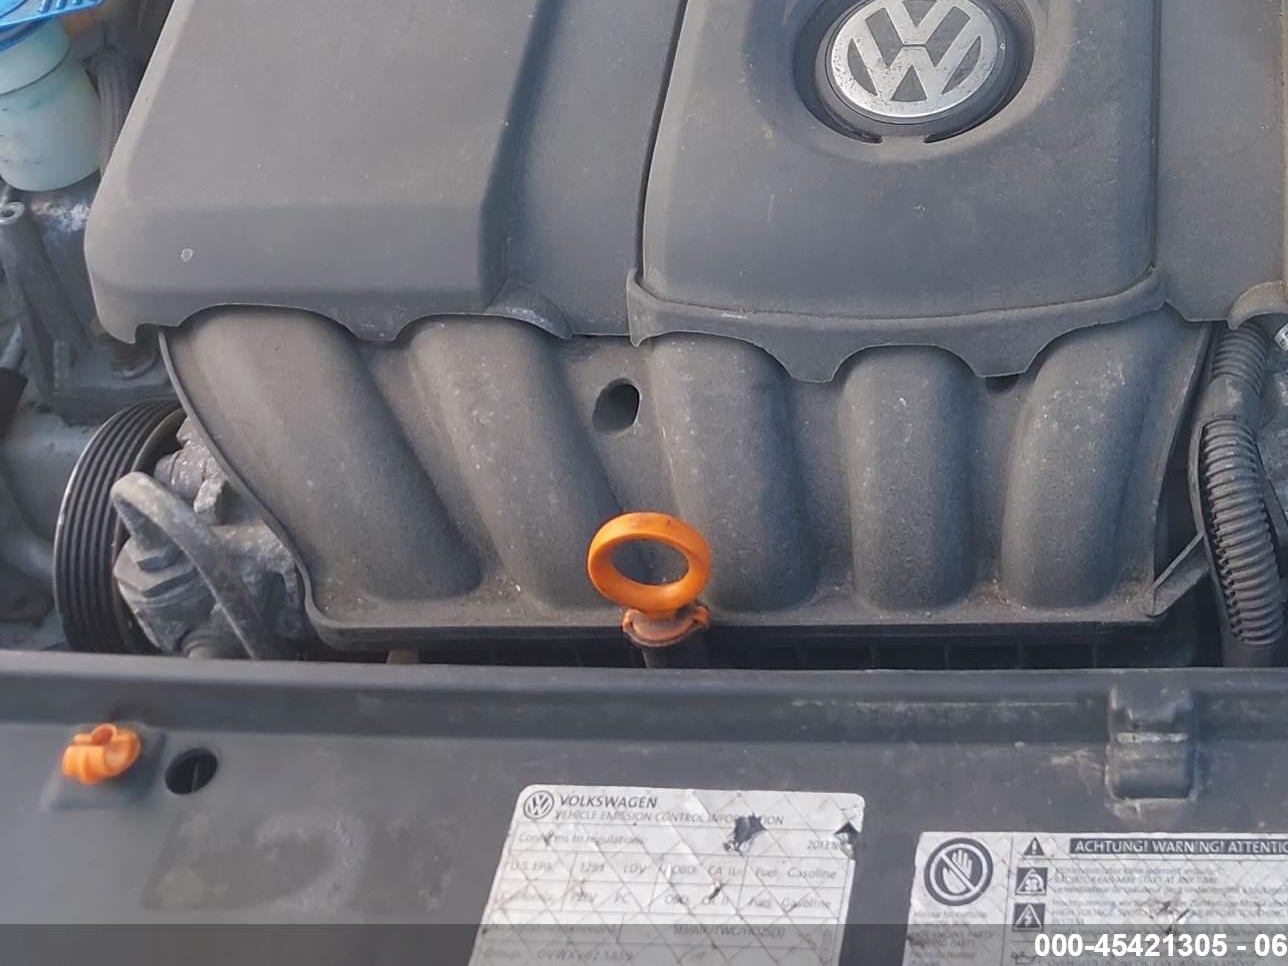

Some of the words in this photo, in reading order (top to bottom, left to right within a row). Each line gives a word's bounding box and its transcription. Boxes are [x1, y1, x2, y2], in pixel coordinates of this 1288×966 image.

[559, 794, 658, 809] VOLKSWAGEN
[1075, 839, 1147, 853] ACHTUNG!
[1151, 839, 1224, 854] WARNING!
